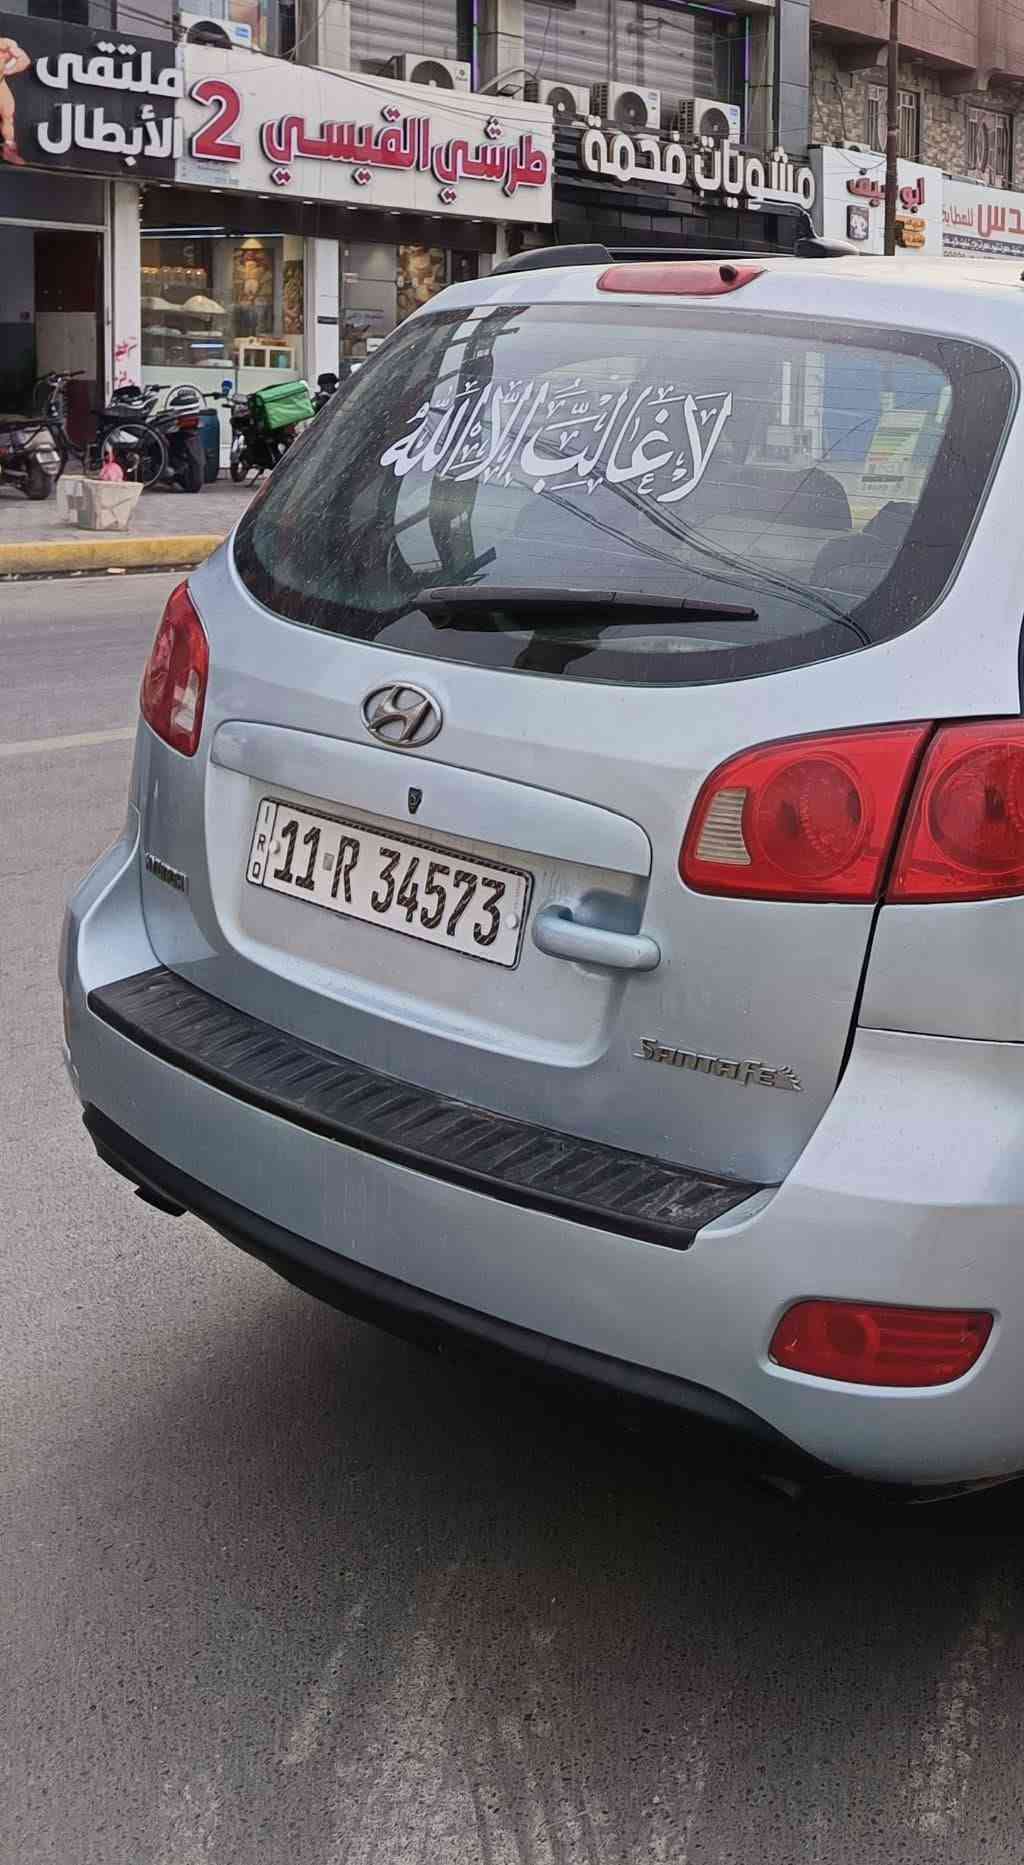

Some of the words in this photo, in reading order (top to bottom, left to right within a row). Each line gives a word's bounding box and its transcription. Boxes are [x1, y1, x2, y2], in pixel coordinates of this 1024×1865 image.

[35, 40, 185, 98] ملتقى
[37, 104, 184, 167] الأبطال
[191, 79, 241, 162] 2
[260, 103, 432, 186] القيسي
[432, 116, 548, 198] طرشي
[694, 135, 815, 210] مشويات
[252, 805, 270, 880] IRQ
[273, 820, 321, 891] 11
[330, 835, 360, 904] R
[371, 846, 505, 947] 34573
